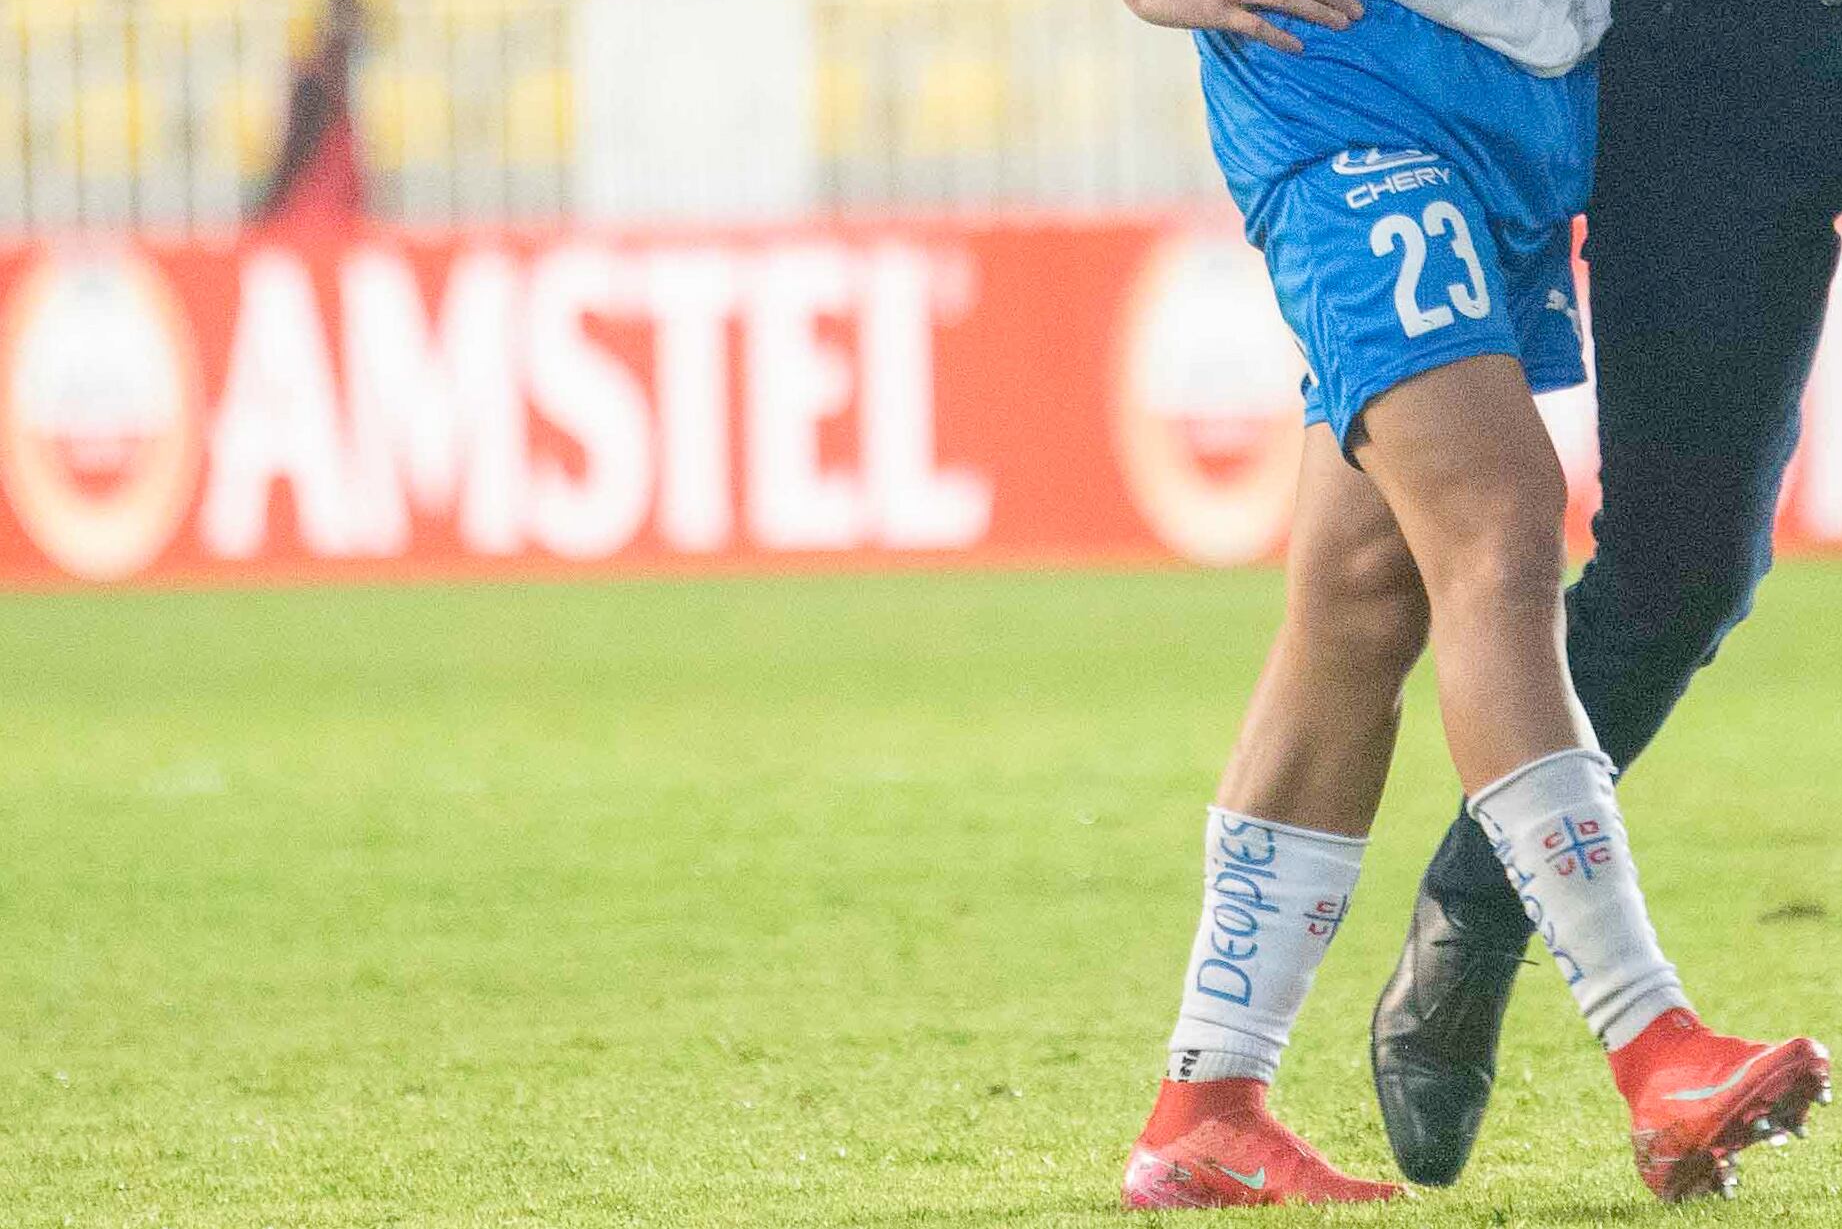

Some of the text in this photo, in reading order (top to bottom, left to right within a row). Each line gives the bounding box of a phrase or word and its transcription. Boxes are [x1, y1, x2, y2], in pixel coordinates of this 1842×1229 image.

[1345, 166, 1450, 209] CHERY
[1370, 200, 1491, 338] 23
[208, 242, 993, 559] AMSTEL
